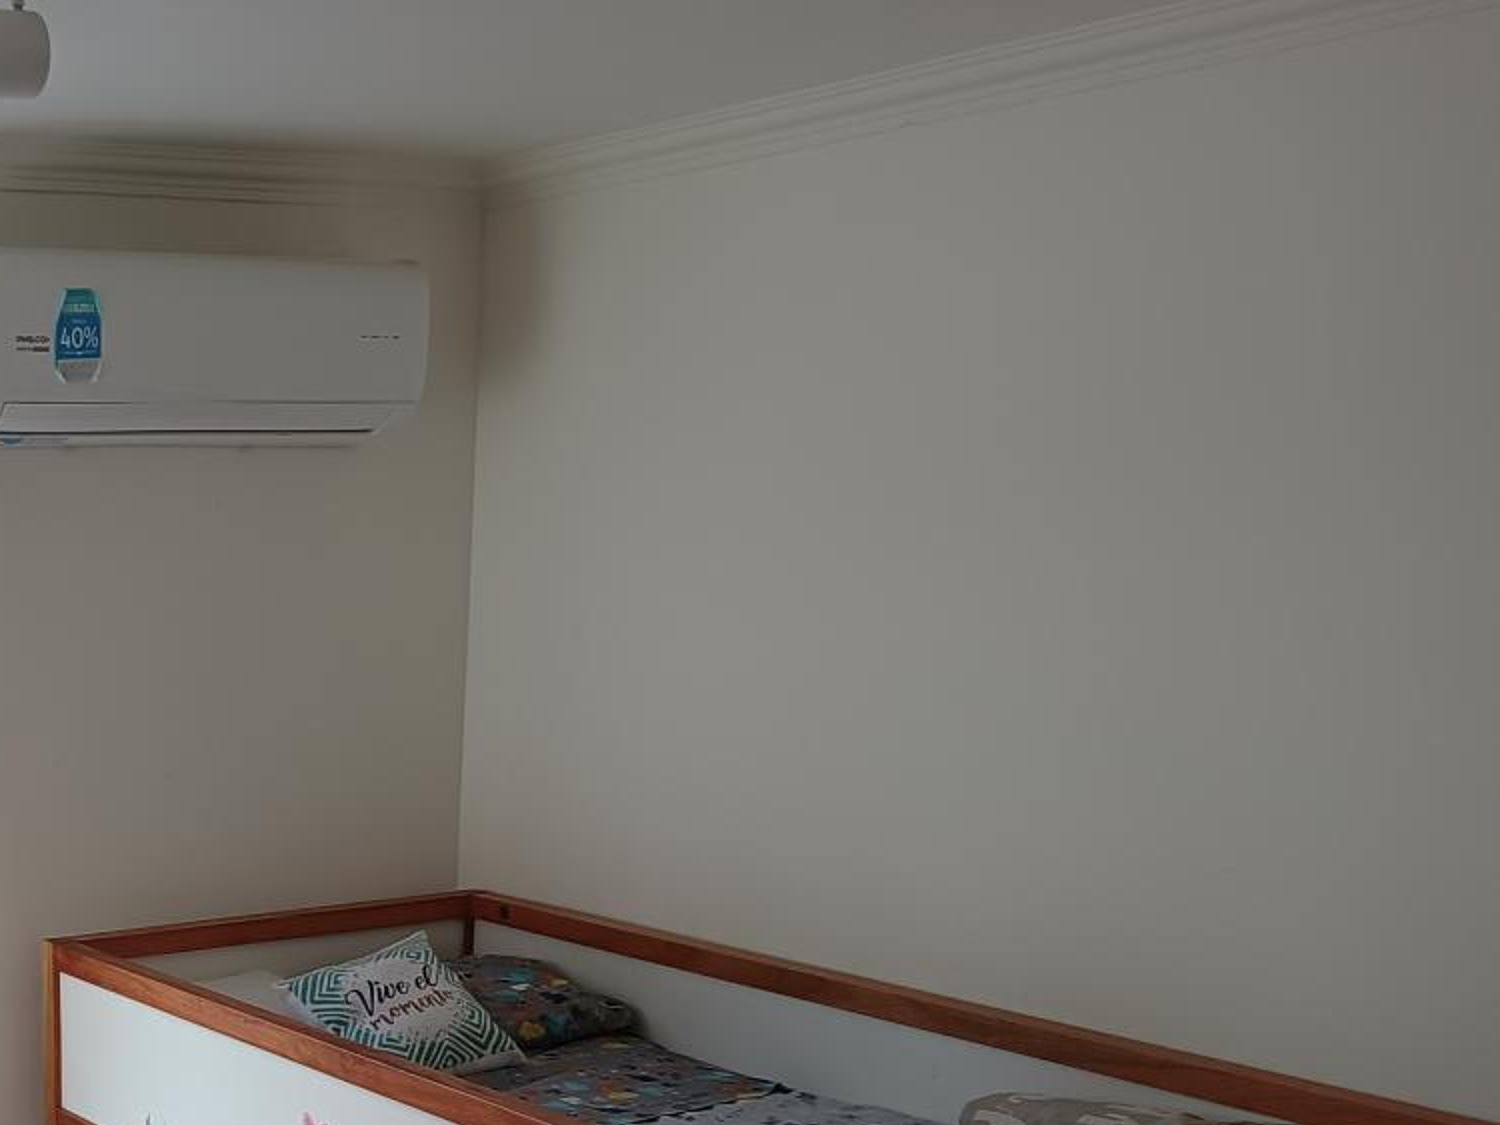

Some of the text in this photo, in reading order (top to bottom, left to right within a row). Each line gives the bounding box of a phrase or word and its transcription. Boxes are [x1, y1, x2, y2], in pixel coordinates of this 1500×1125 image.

[60, 325, 99, 349] 40%
[345, 964, 438, 1017] Vive el
[370, 988, 453, 1030] momento
